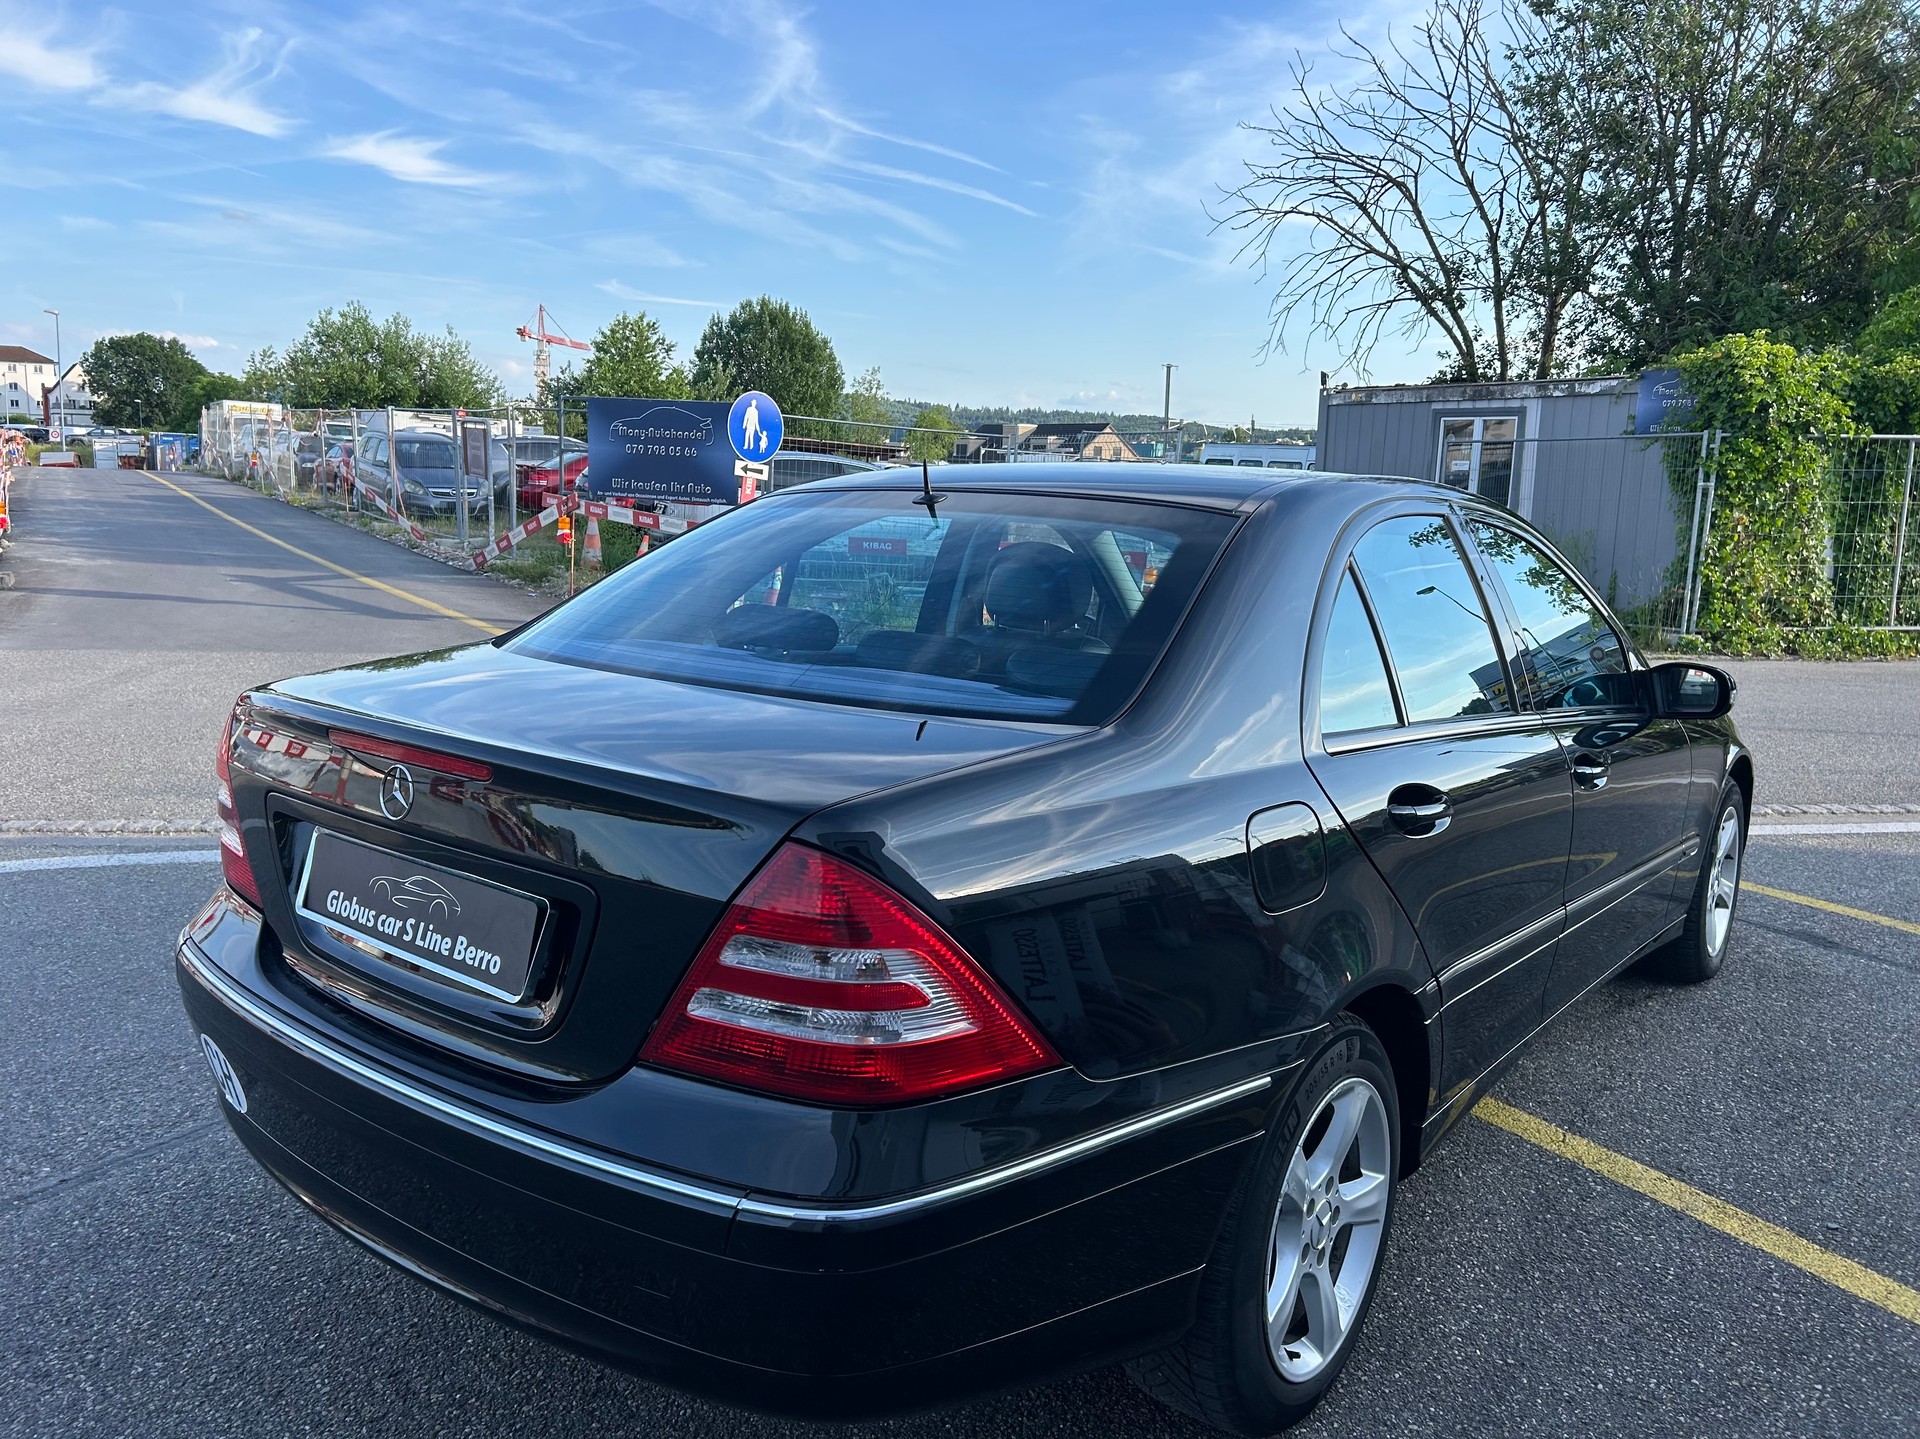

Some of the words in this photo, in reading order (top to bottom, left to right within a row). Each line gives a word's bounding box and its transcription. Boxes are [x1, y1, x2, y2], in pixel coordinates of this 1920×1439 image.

[618, 426, 706, 440] Mony-Autohandel
[625, 444, 644, 453] 079
[647, 445, 666, 455] 798
[669, 446, 681, 456] 05
[684, 447, 697, 457] 66
[612, 478, 629, 489] Wir
[631, 480, 667, 491] kaufen
[670, 482, 685, 492] Ihr
[687, 483, 712, 494] Auto
[745, 477, 753, 494] KIB
[862, 541, 892, 550] KIBAG
[326, 889, 375, 928] Globus
[376, 912, 403, 938] car
[402, 917, 416, 943] S
[415, 922, 452, 956] Line
[453, 935, 501, 975] Berro
[1330, 1056, 1335, 1068] R
